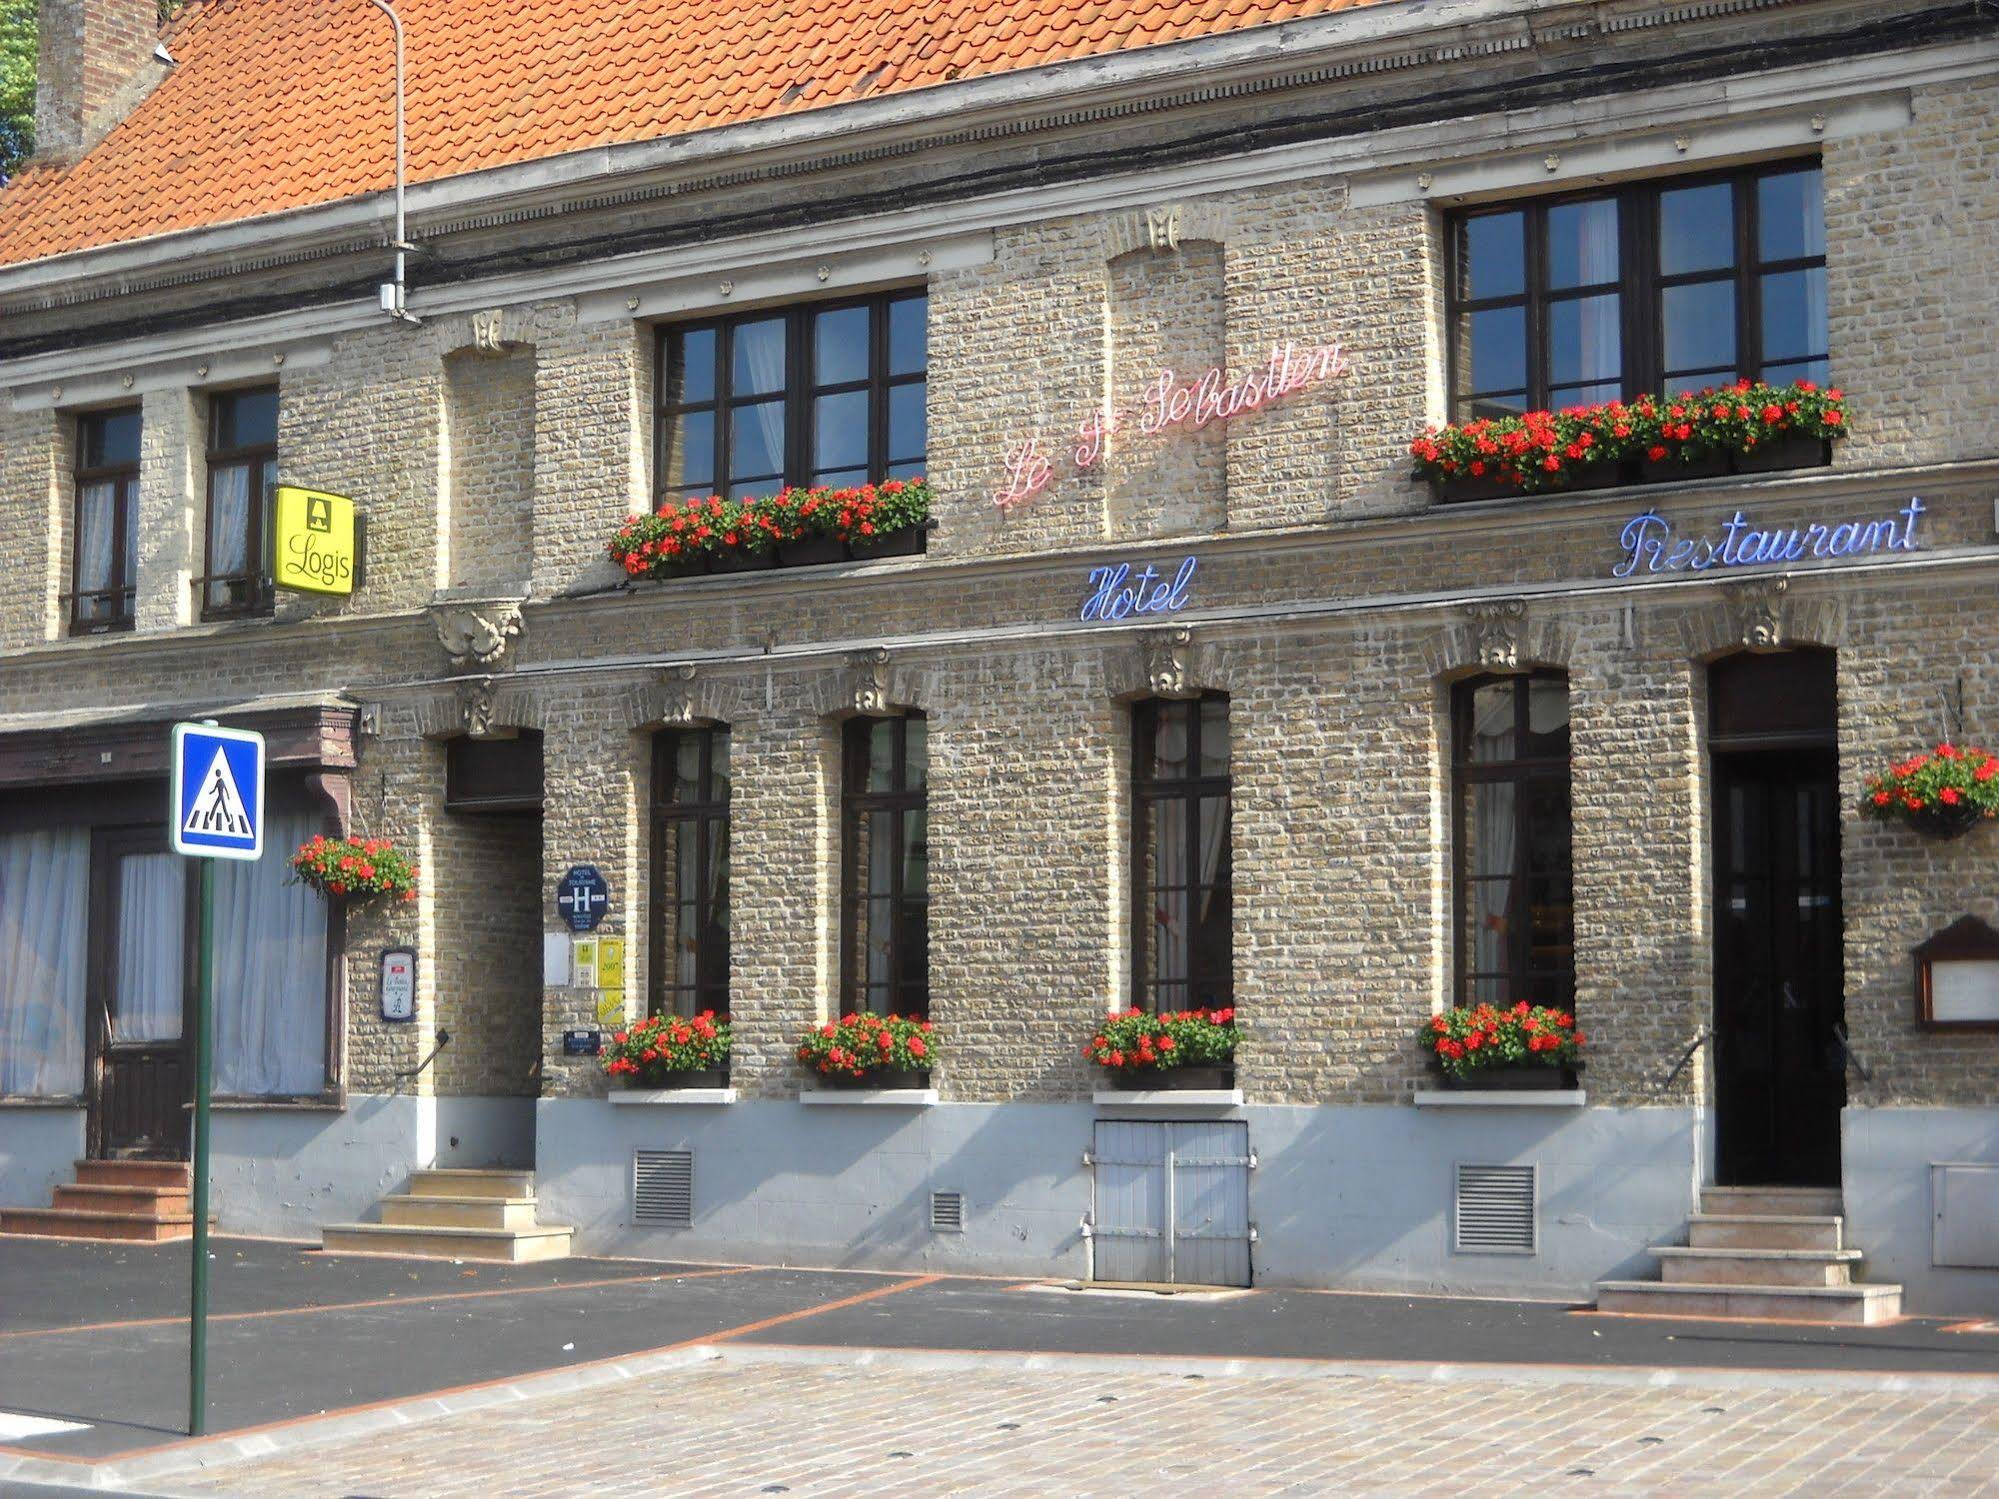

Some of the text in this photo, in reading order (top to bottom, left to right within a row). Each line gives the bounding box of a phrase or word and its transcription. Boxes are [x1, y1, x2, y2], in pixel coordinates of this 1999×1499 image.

[993, 437, 1050, 505] Le
[1141, 340, 1348, 433] Sebastien
[286, 533, 350, 586] Logis
[1612, 496, 1926, 578] Restaurant
[1080, 556, 1197, 622] Hotel
[573, 886, 590, 912] H
